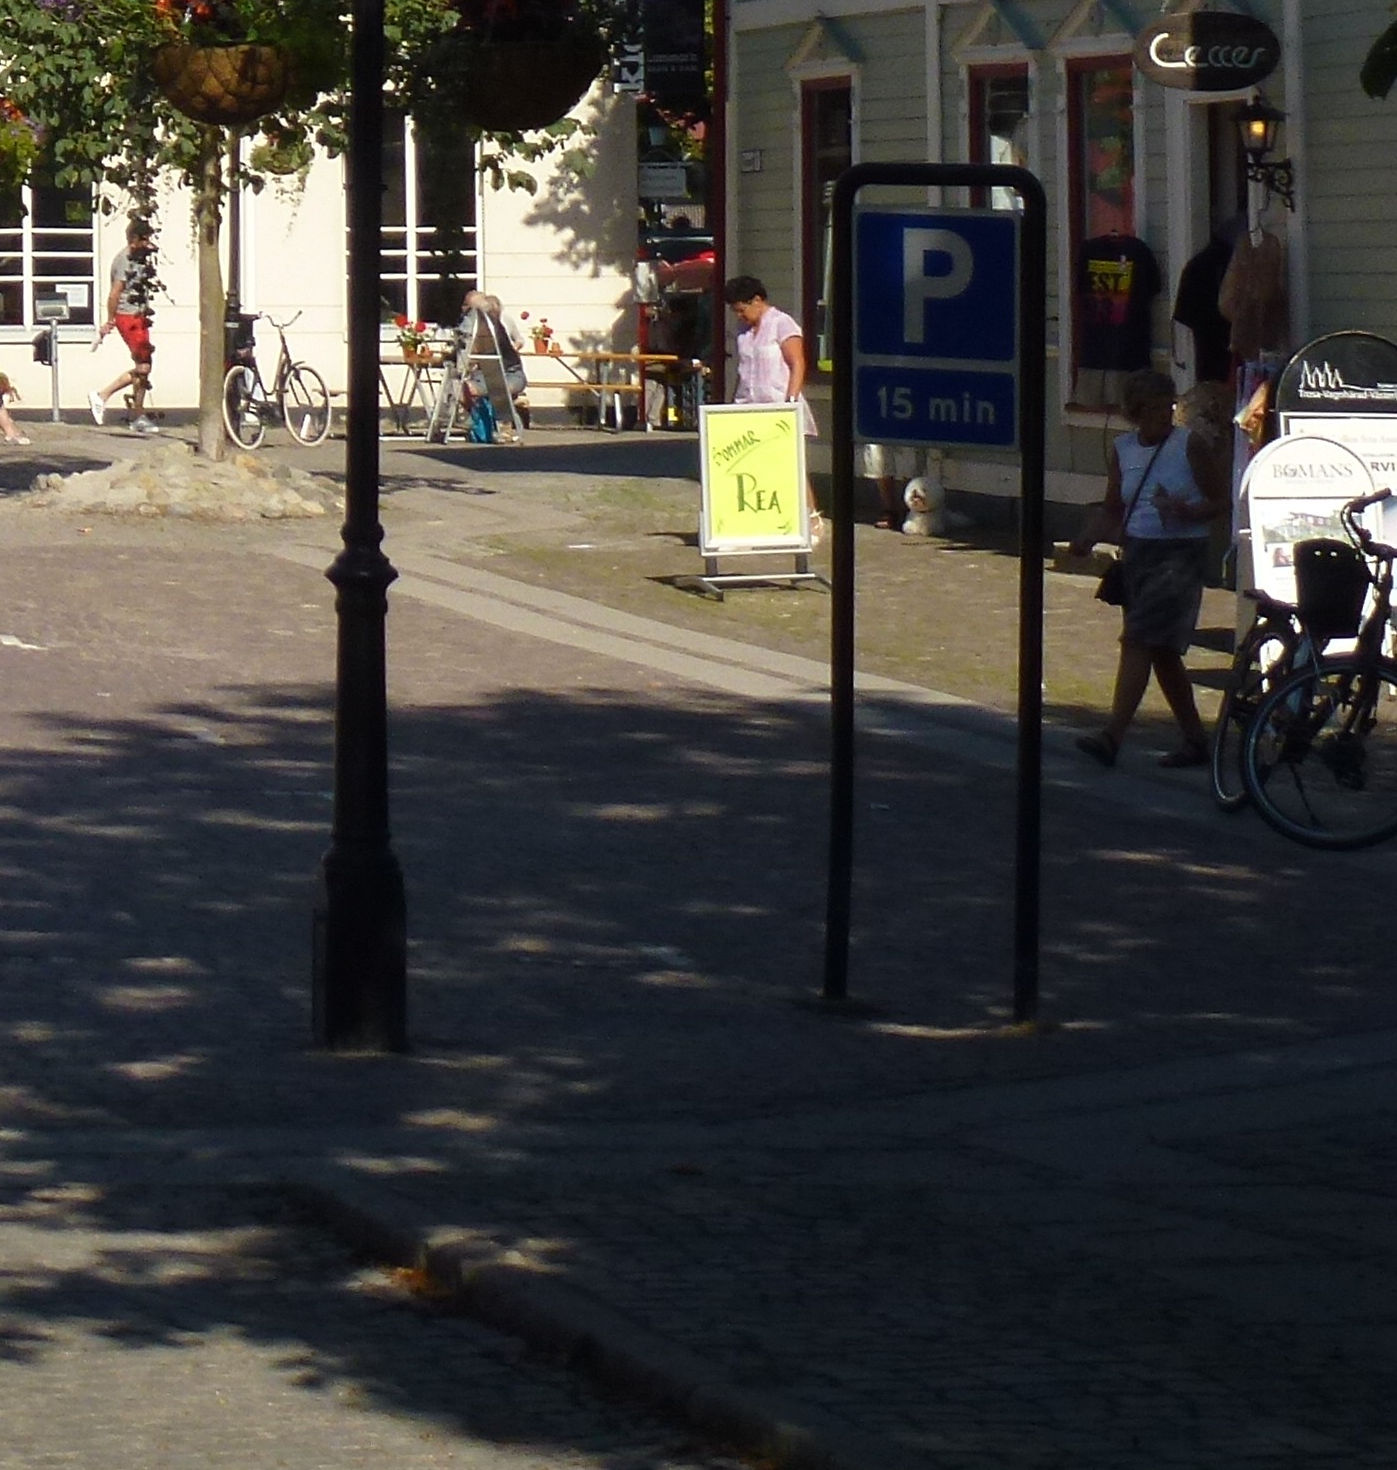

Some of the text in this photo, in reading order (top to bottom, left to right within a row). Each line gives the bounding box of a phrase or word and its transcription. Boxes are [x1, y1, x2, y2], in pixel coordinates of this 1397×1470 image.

[903, 227, 974, 344] P
[877, 386, 996, 425] 15 min
